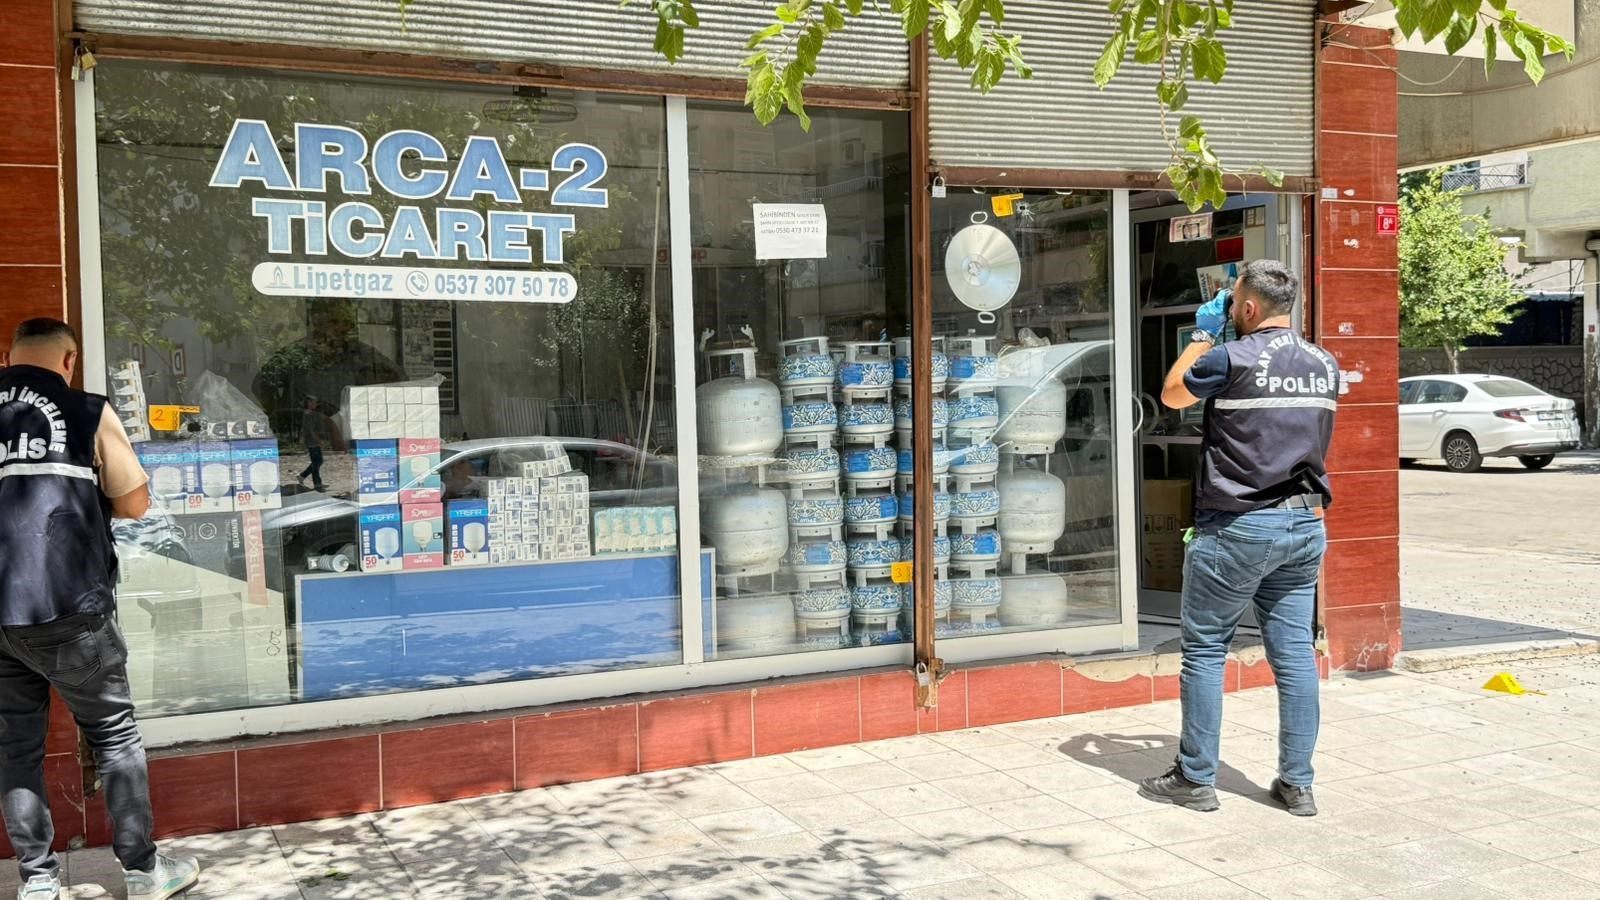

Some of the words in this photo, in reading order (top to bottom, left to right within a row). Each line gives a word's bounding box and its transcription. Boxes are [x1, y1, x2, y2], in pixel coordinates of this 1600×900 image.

[208, 118, 608, 208] ARCA-2
[293, 266, 393, 295] Lipetgaz
[434, 273, 478, 295] 0537
[484, 275, 515, 296] 307
[522, 276, 544, 297] 50
[548, 277, 569, 297] 78
[1255, 350, 1272, 387] OLAY
[1268, 372, 1328, 393] POLİS
[18, 386, 67, 453] İNCELEME
[153, 409, 164, 421] 2
[189, 495, 202, 504] 60
[238, 492, 251, 502] 60
[246, 514, 260, 582] LUXELL
[453, 550, 464, 558] 50
[366, 556, 377, 565] 50
